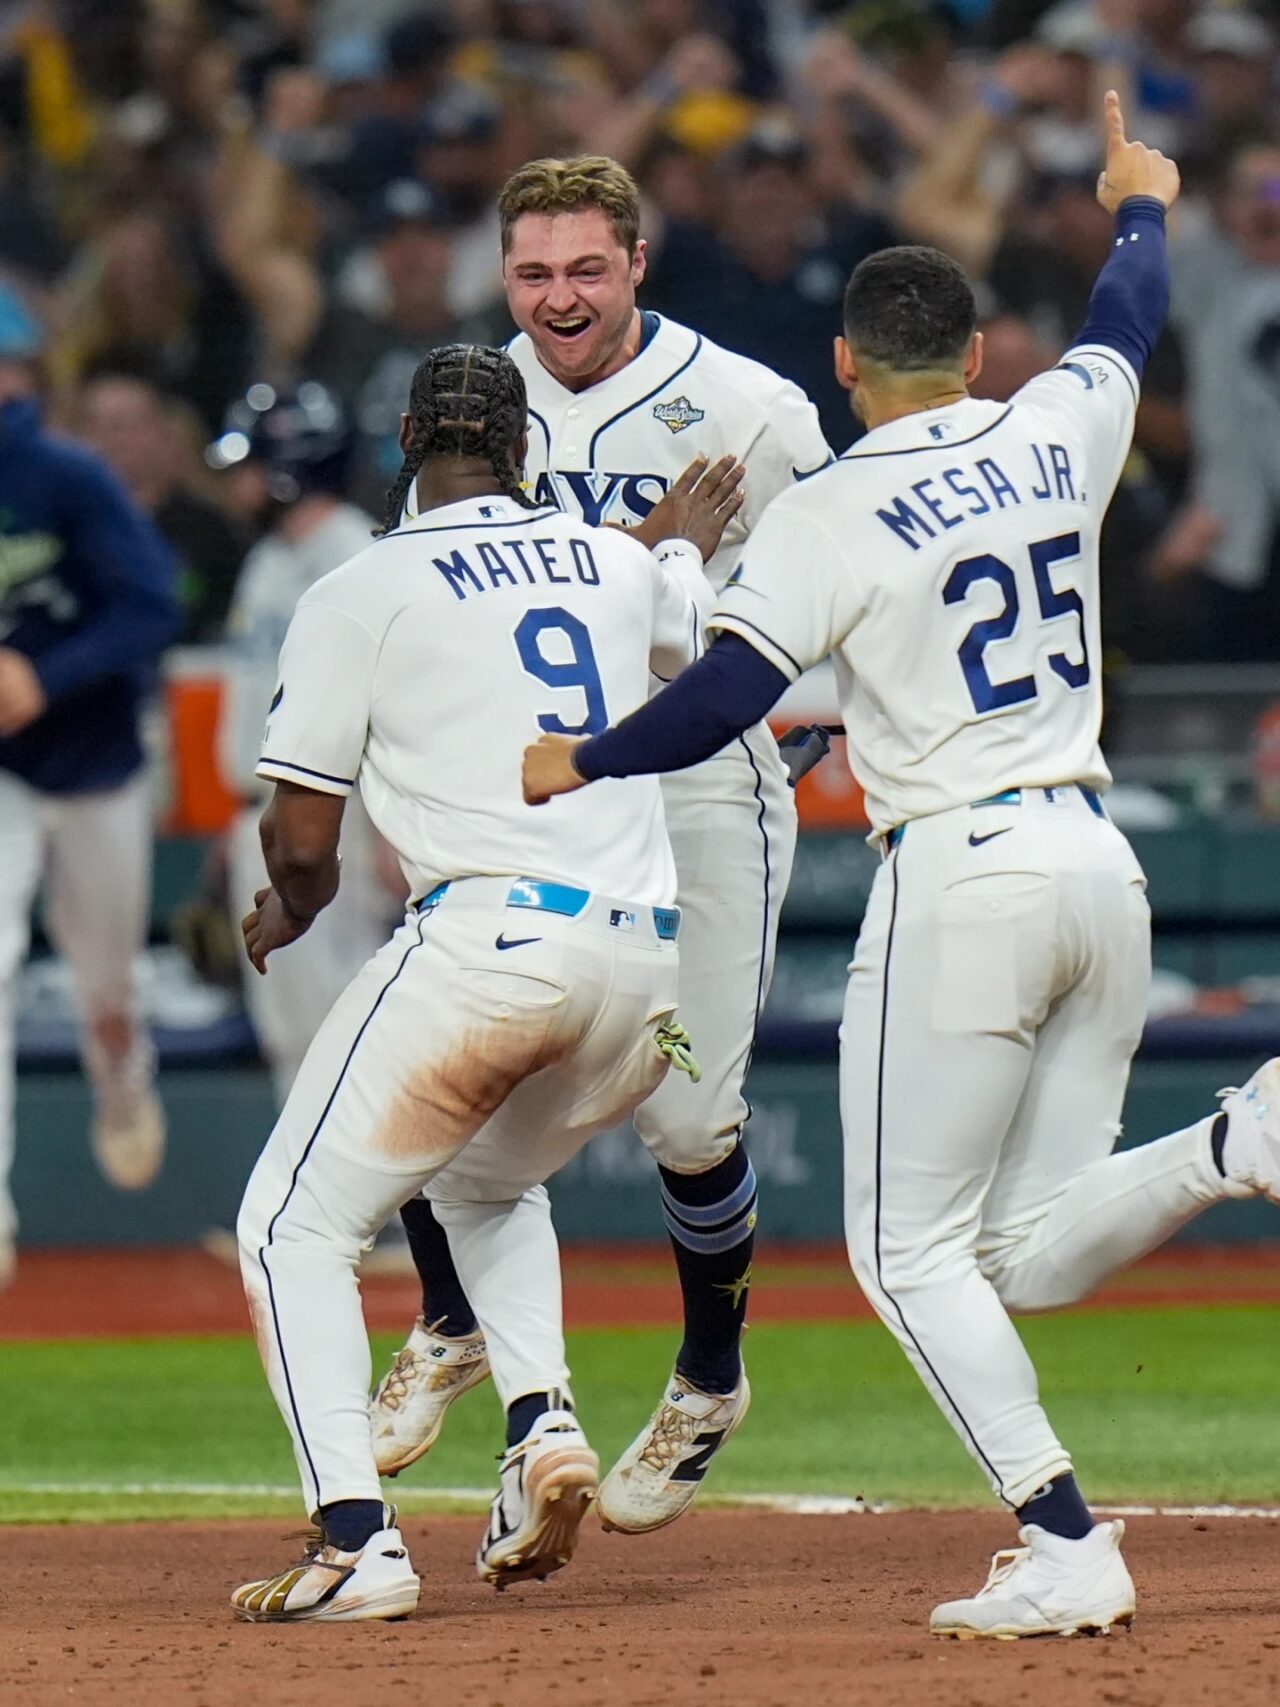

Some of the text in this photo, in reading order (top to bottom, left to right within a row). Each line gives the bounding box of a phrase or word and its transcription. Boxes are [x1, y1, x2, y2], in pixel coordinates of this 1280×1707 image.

[535, 470, 674, 528] AYS
[875, 443, 1086, 551] MESA JR.
[431, 537, 600, 600] MATEO
[942, 530, 1090, 714] 25
[513, 606, 609, 736] 9
